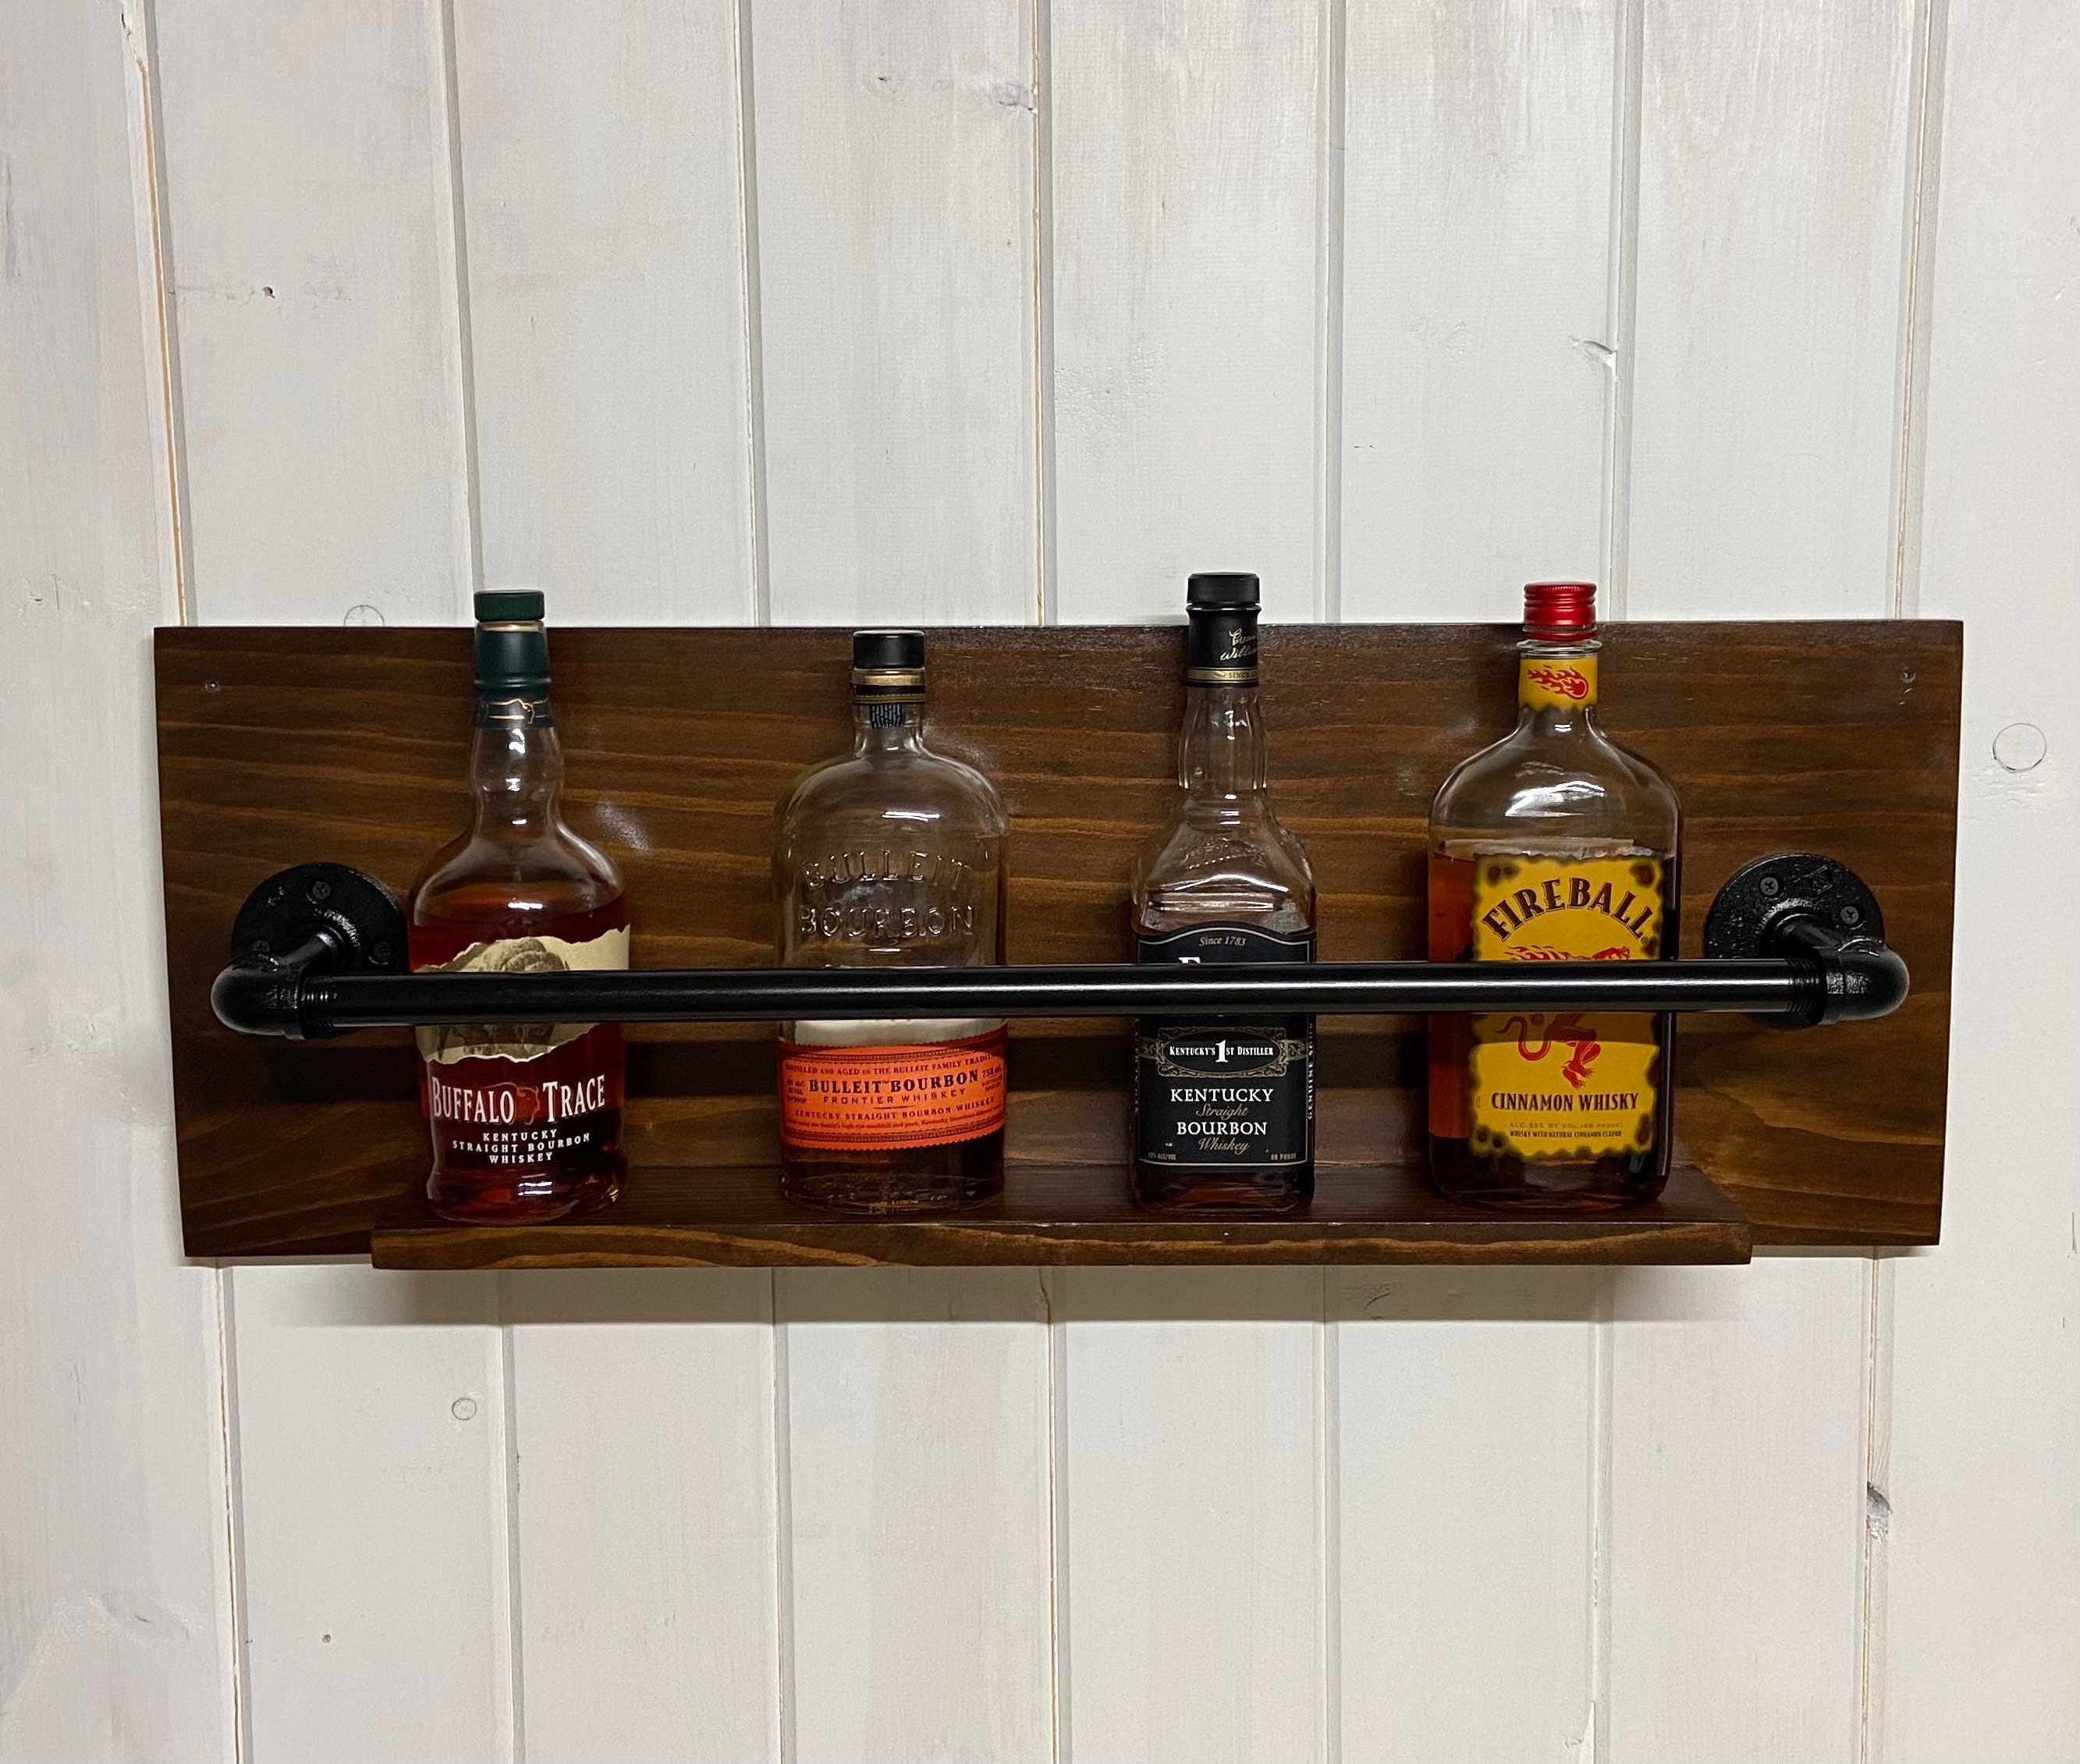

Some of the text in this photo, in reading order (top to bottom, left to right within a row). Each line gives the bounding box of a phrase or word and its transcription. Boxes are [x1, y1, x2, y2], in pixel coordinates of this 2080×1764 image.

[802, 849, 971, 891] BULLEIT
[1482, 877, 1653, 942] FIREBALL
[799, 906, 973, 937] BOURBON
[1198, 936, 1247, 946] Since 1783
[1170, 1046, 1216, 1056] KENTUCKY'S
[1237, 1046, 1273, 1056] DISTILLER
[932, 1060, 962, 1070] FAMILY
[809, 1079, 881, 1094] BULLEIT
[890, 1070, 978, 1092] BOURBON
[431, 1074, 605, 1124] BUFFALO TRACE
[901, 1088, 966, 1102] WHISKEY
[1170, 1088, 1274, 1102] KENTUCKY
[1492, 1092, 1573, 1111] CINNAMON
[1579, 1092, 1638, 1111] WHISKY
[795, 1109, 840, 1120] KENTUCKY
[902, 1106, 951, 1118] BOURBON
[1195, 1103, 1248, 1120] Straight
[482, 1129, 558, 1141] KENTUCKY
[1177, 1122, 1268, 1135] BOURBON
[452, 1133, 591, 1153] STRAIGHT BOURBON
[1198, 1137, 1251, 1155] Whiskey
[488, 1152, 553, 1164] WHISKEY
